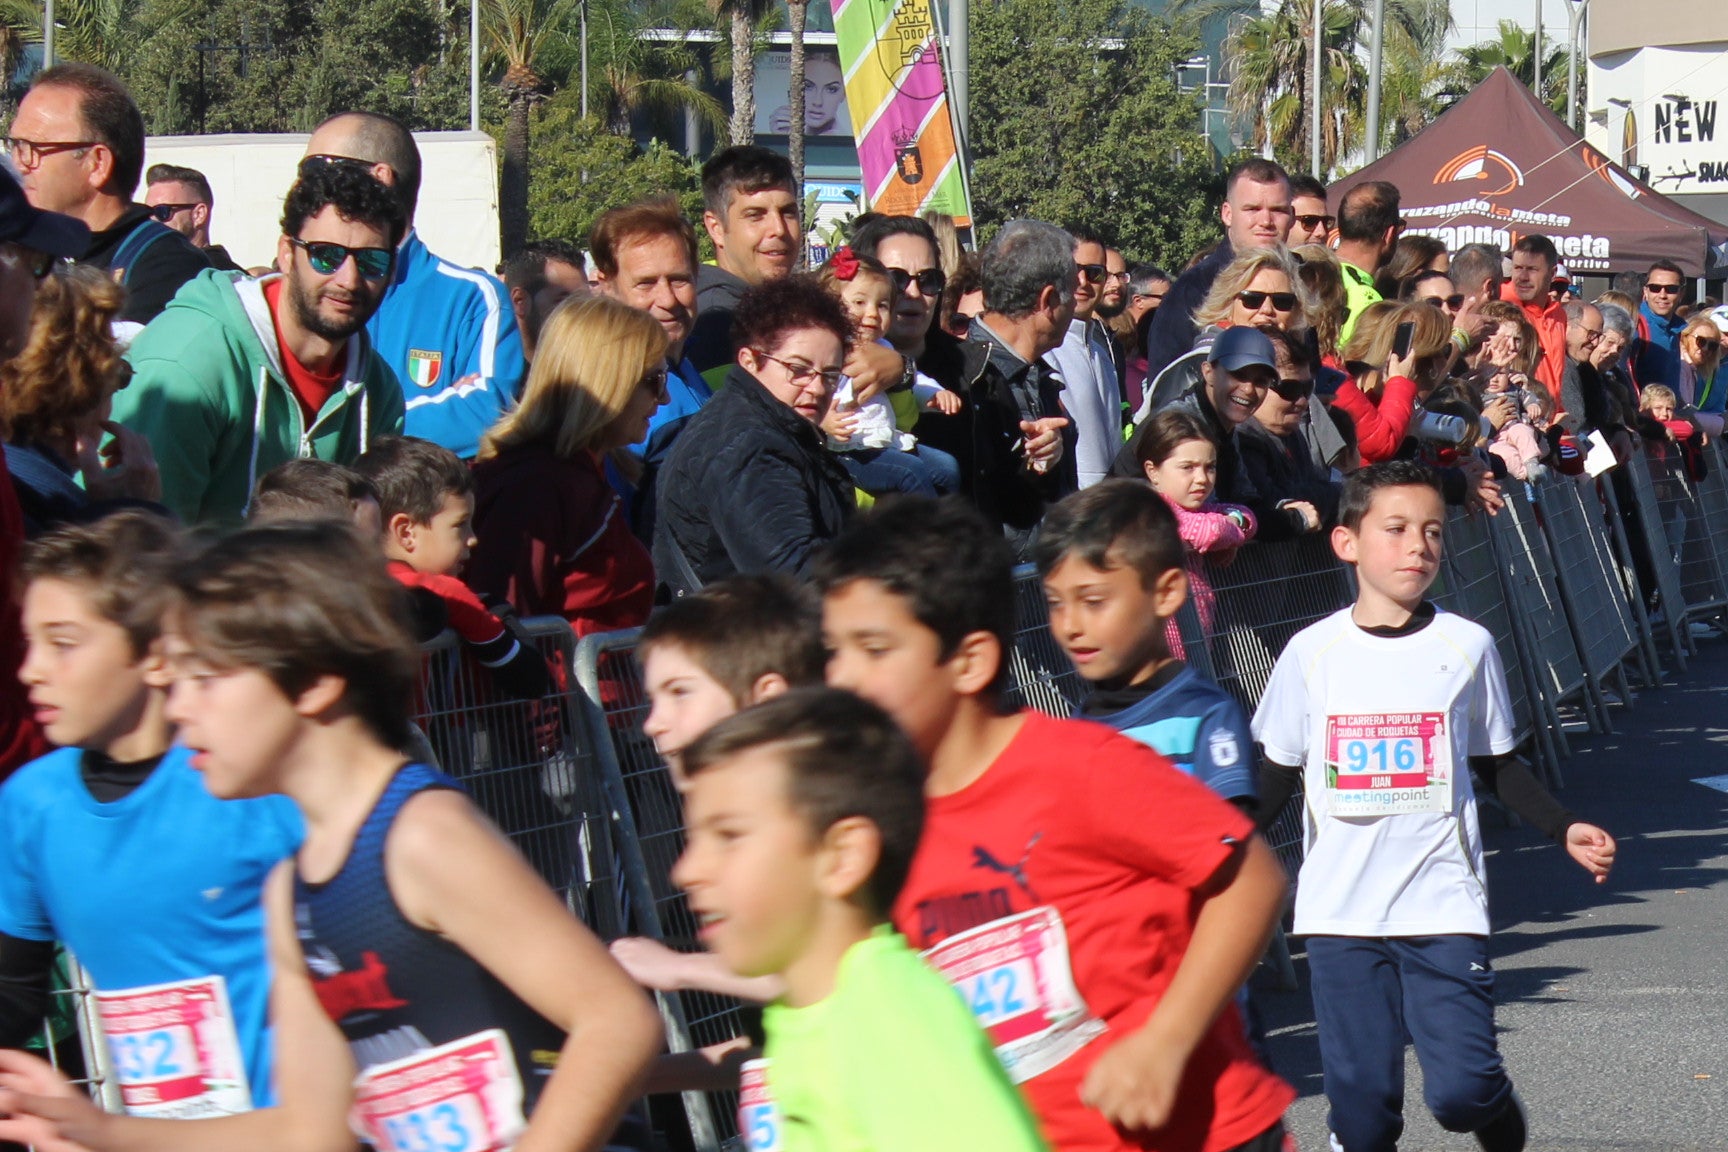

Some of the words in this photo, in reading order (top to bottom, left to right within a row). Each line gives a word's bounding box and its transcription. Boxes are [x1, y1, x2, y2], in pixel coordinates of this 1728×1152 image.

[1655, 101, 1717, 144] NEW
[1337, 727, 1363, 737] CIUDAD
[1365, 727, 1376, 736] DE
[1377, 725, 1419, 736] ROQUETAS
[1348, 716, 1384, 725] CARRERA
[1387, 714, 1422, 724] POPULAR
[1346, 739, 1416, 772] 916
[1371, 775, 1392, 788] JUAN
[968, 967, 1024, 1018] 42
